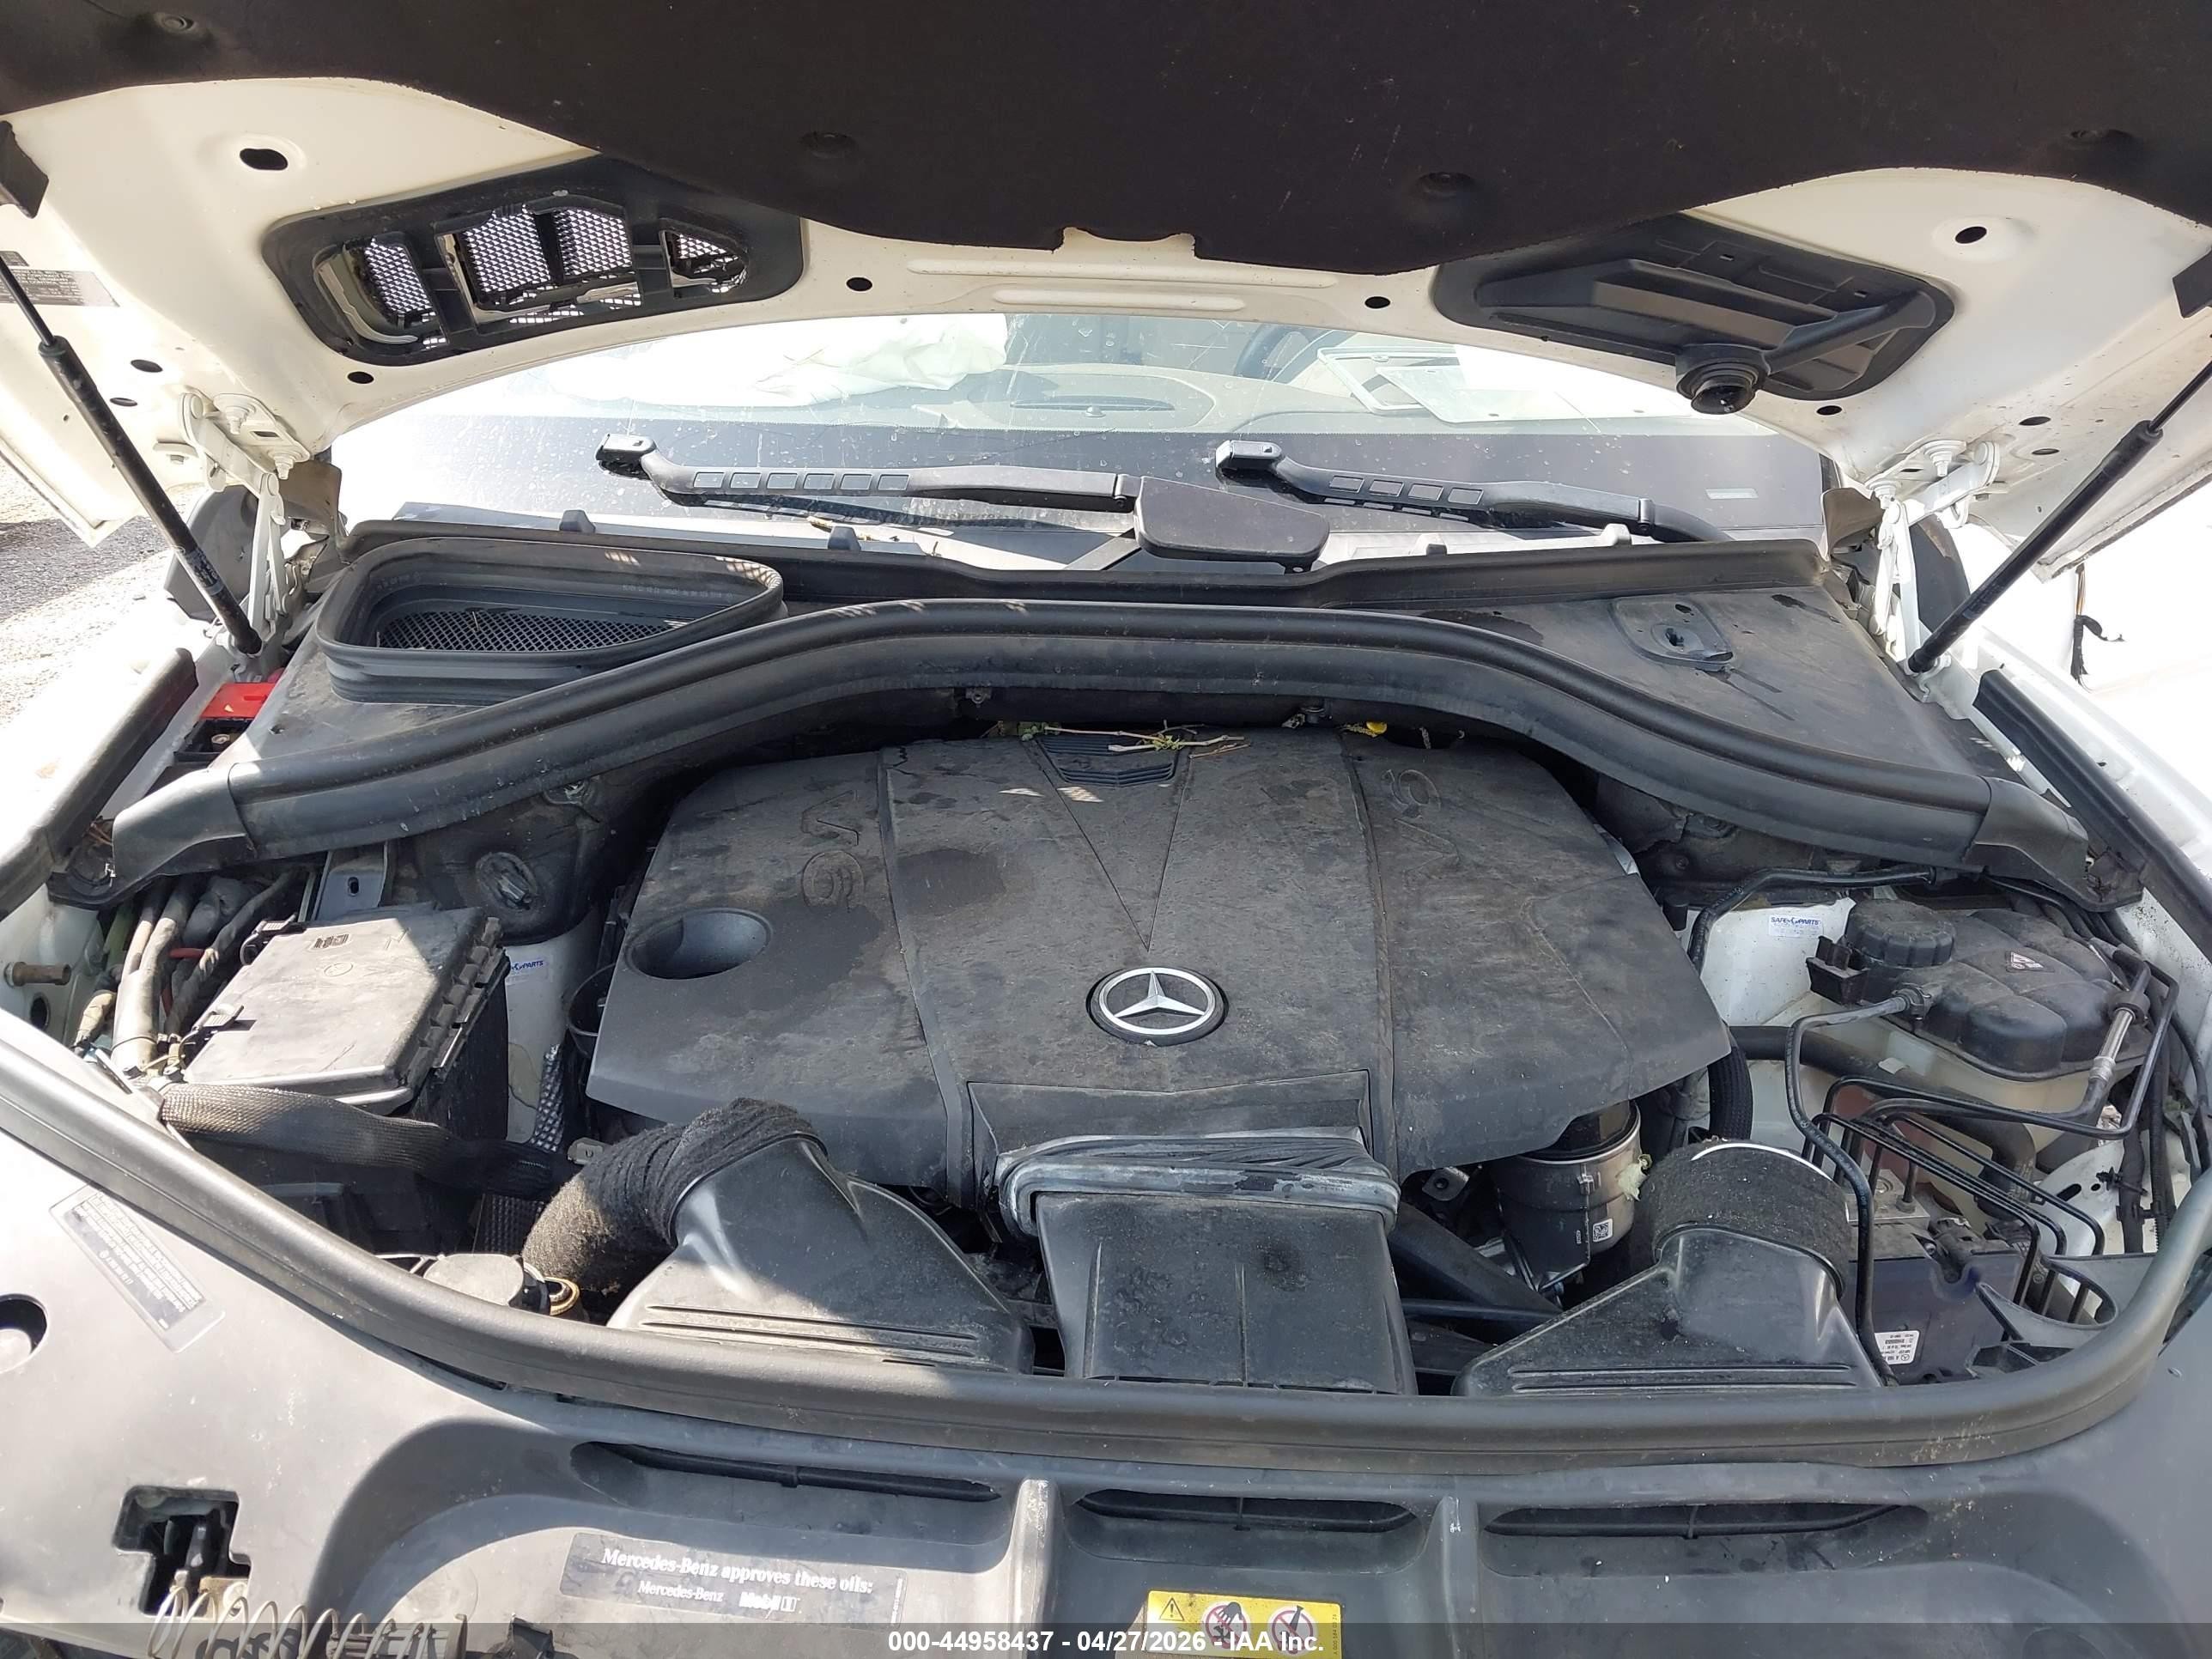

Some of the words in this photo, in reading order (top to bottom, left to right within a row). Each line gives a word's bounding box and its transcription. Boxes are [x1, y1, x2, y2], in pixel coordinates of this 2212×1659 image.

[602, 1548, 719, 1577] Mercedes-Benz
[720, 1564, 792, 1586] approves
[795, 1570, 836, 1590] these
[638, 1578, 726, 1603] Mercedes-Benz
